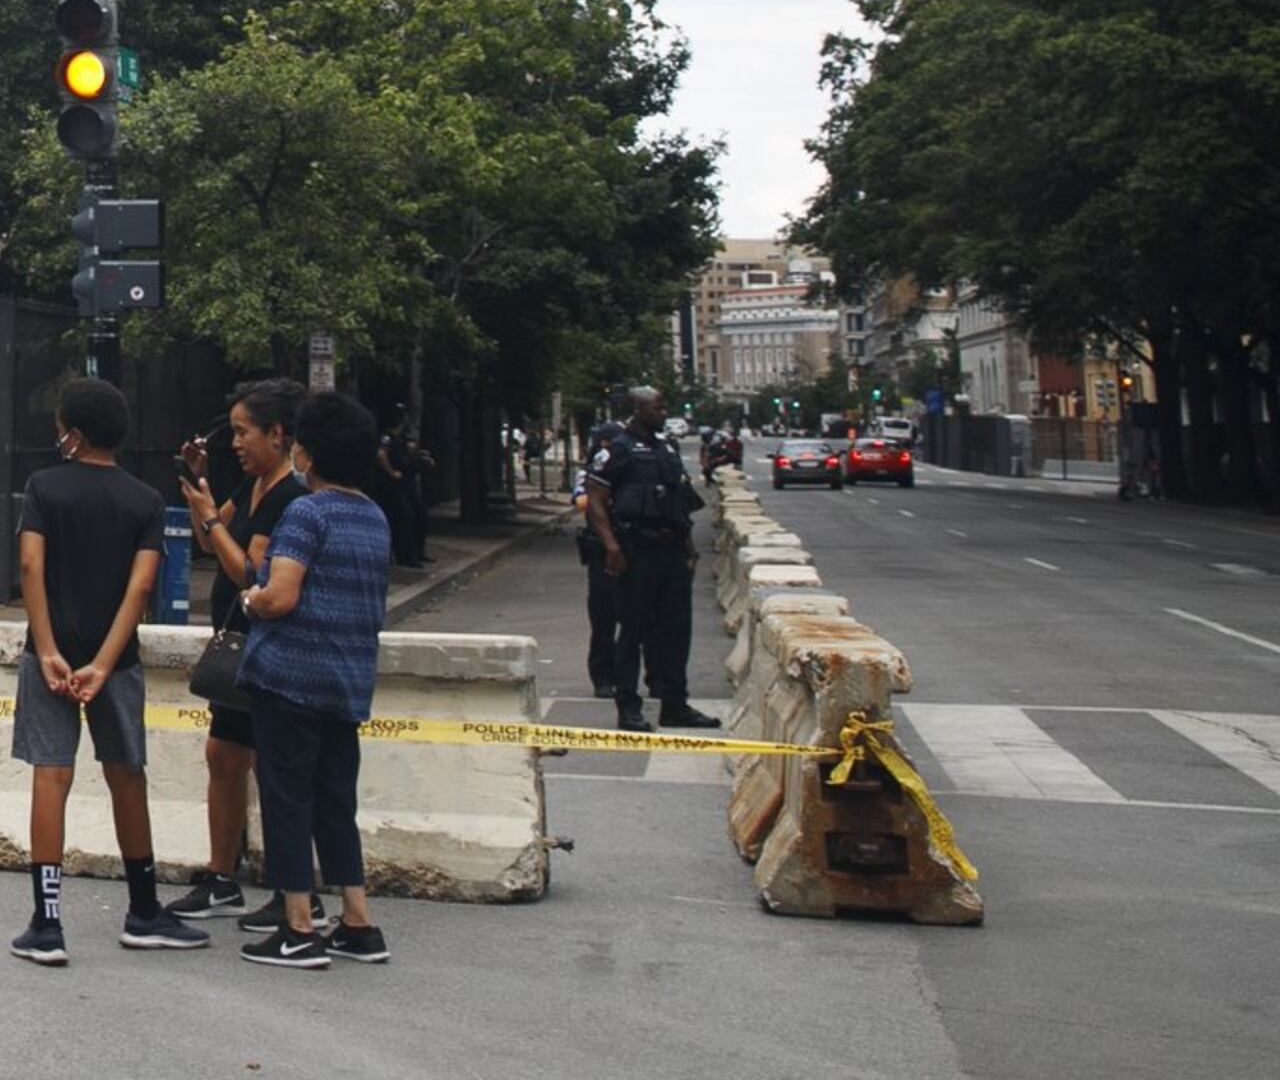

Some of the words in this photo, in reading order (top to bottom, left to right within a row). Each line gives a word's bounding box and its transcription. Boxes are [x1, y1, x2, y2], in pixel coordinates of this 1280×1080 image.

[178, 708, 212, 720] POL
[462, 723, 528, 736] POLICE
[535, 728, 575, 740] LINE
[481, 734, 523, 744] CRIME
